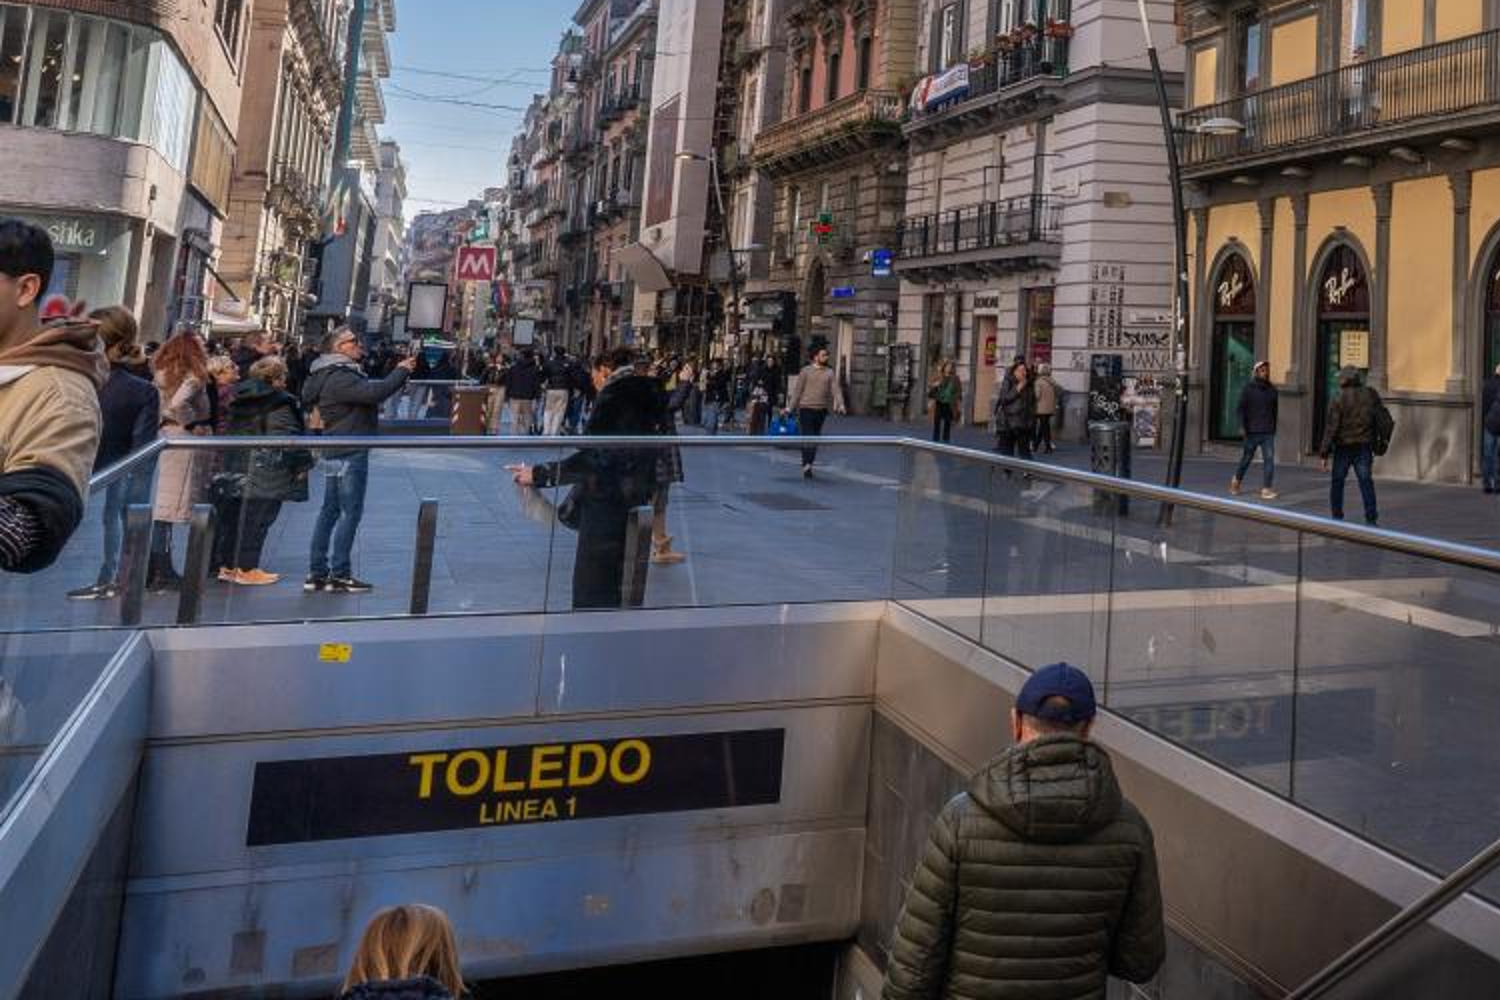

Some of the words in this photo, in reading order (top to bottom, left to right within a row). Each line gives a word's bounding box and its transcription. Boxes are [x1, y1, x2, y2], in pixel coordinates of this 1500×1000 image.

[47, 220, 95, 247] shka
[461, 253, 490, 275] M
[409, 739, 651, 798] TOLEDO
[480, 799, 558, 824] LINEA
[567, 797, 577, 817] 1
